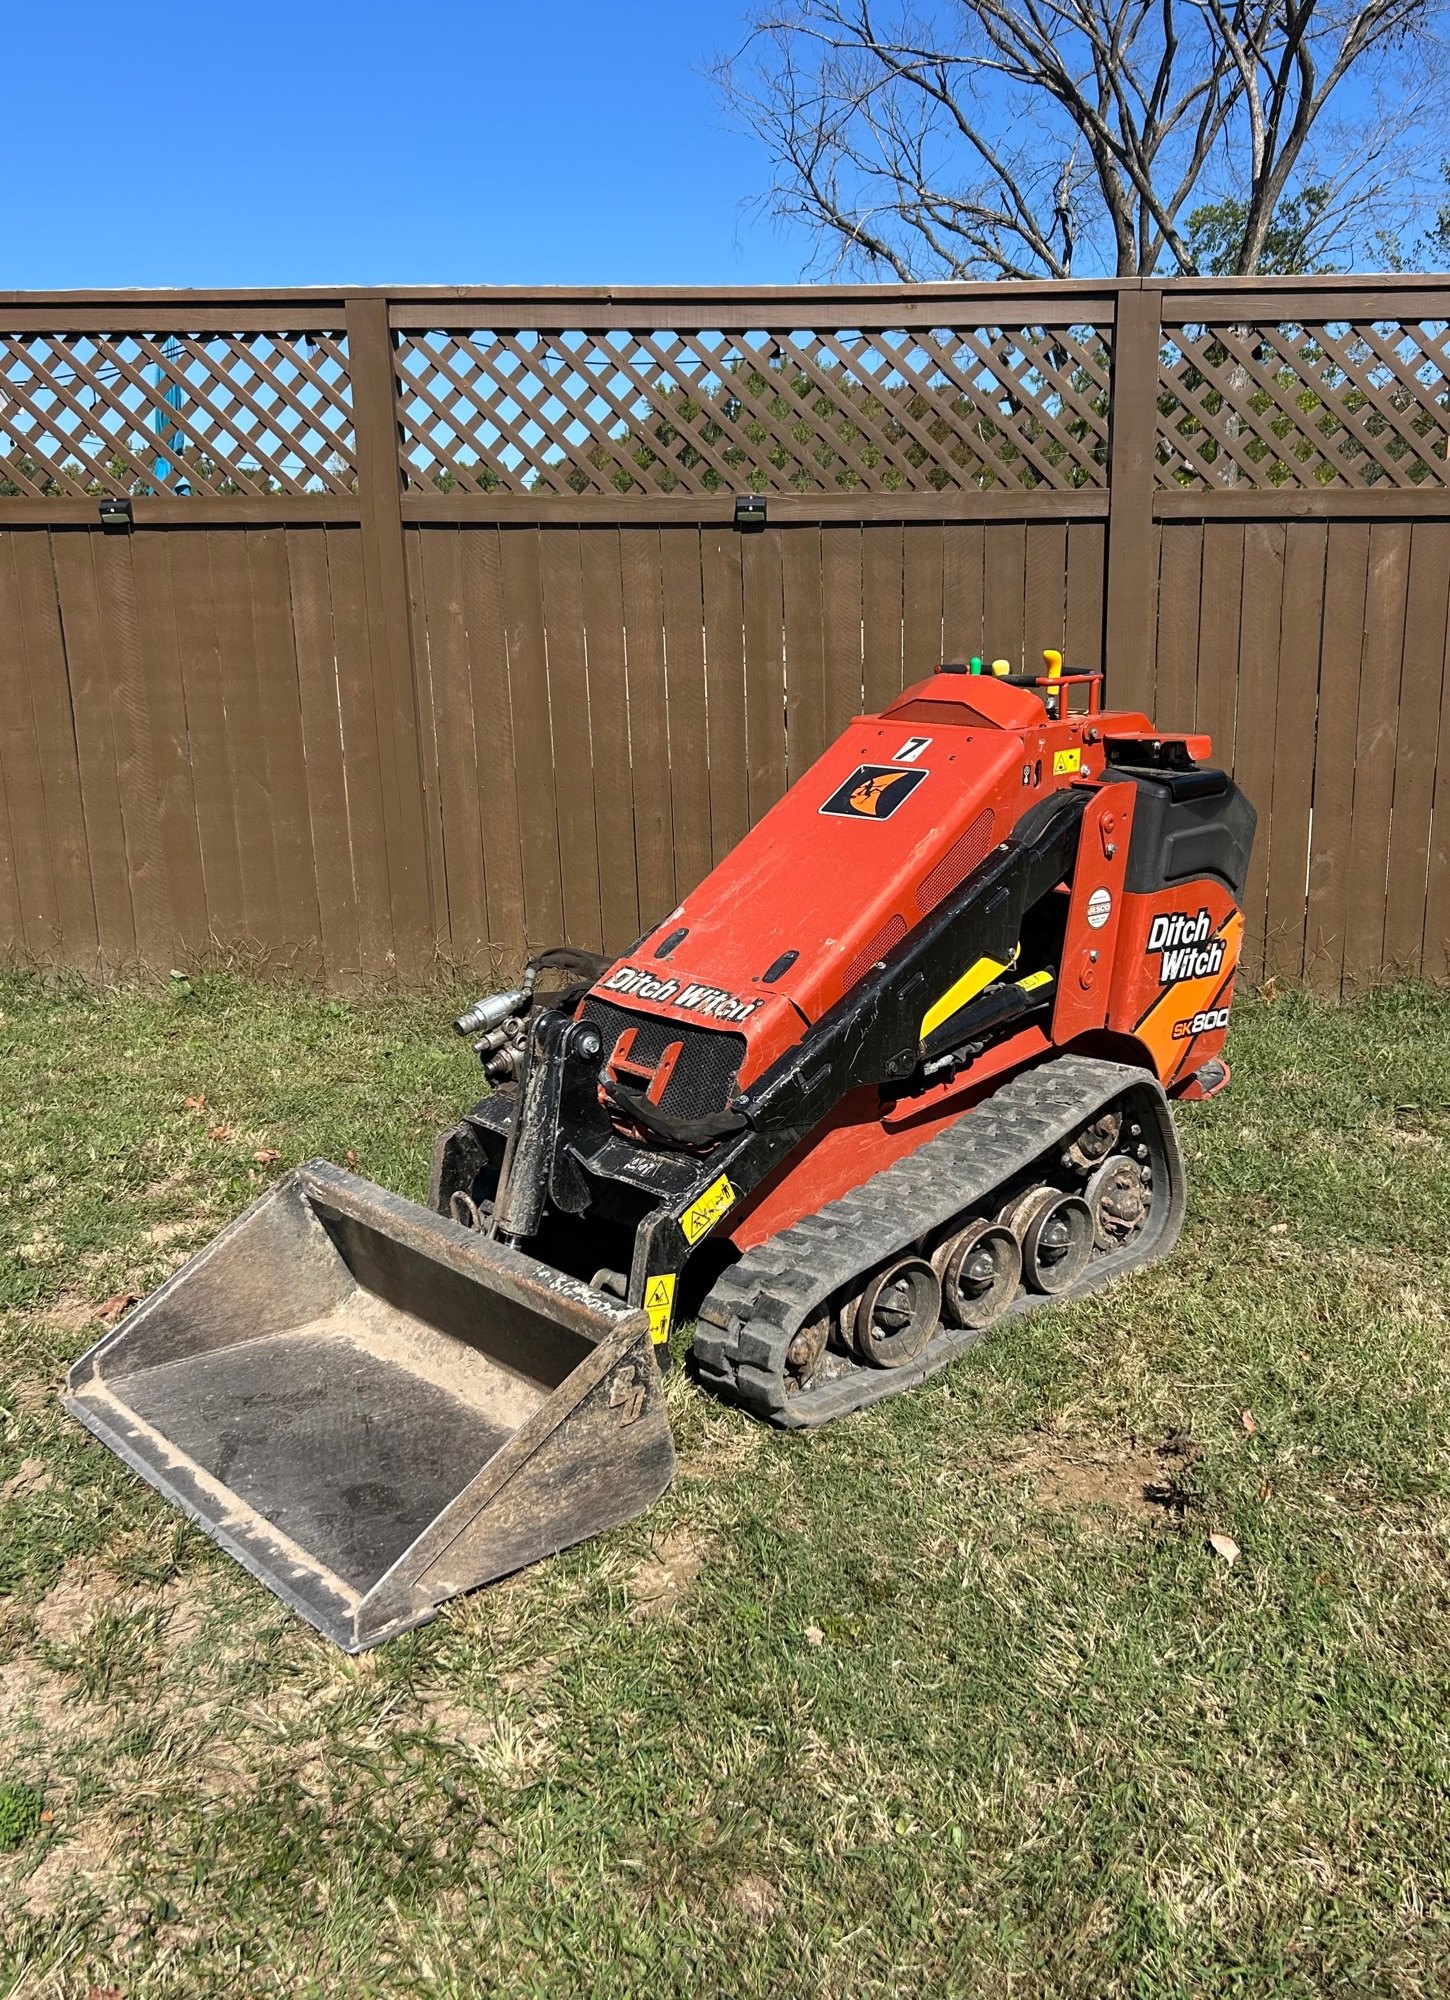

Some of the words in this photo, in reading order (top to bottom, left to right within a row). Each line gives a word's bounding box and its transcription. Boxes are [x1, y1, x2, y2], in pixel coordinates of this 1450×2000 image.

[895, 738, 930, 760] 7
[1147, 910, 1211, 950] Ditch
[1160, 942, 1222, 982] Witch
[604, 966, 681, 1002] Ditch
[672, 983, 758, 1021] Witch
[1172, 1008, 1229, 1038] SK800
